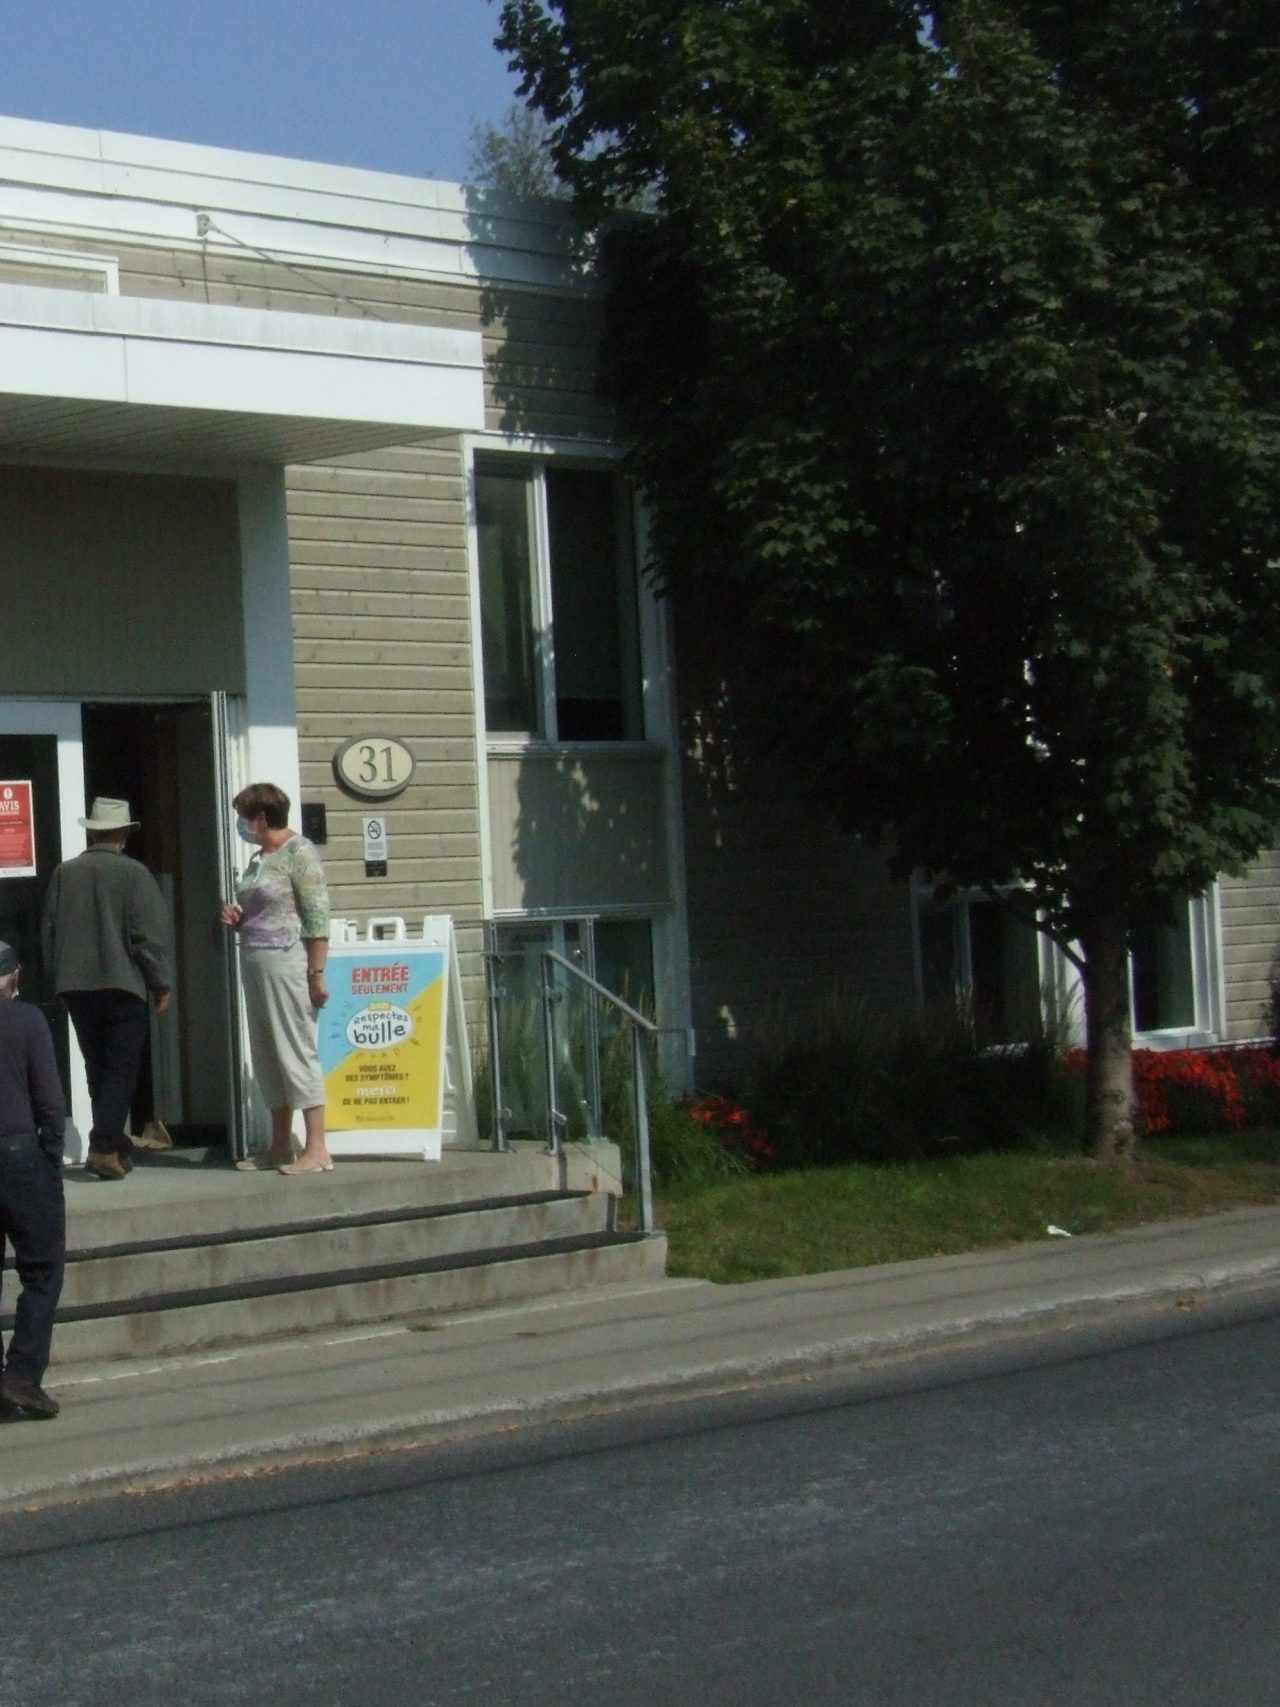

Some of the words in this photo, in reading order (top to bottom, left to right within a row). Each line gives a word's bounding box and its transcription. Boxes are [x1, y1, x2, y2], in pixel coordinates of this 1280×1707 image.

[359, 745, 397, 783] 31
[352, 963, 408, 982] ENTRÉE
[352, 984, 408, 995] SEULEMENT
[353, 1020, 406, 1044] bulle
[359, 1064, 378, 1072] VOUS
[379, 1064, 396, 1072] AVEZ
[345, 1074, 359, 1082] DES
[364, 1097, 378, 1105] PAS
